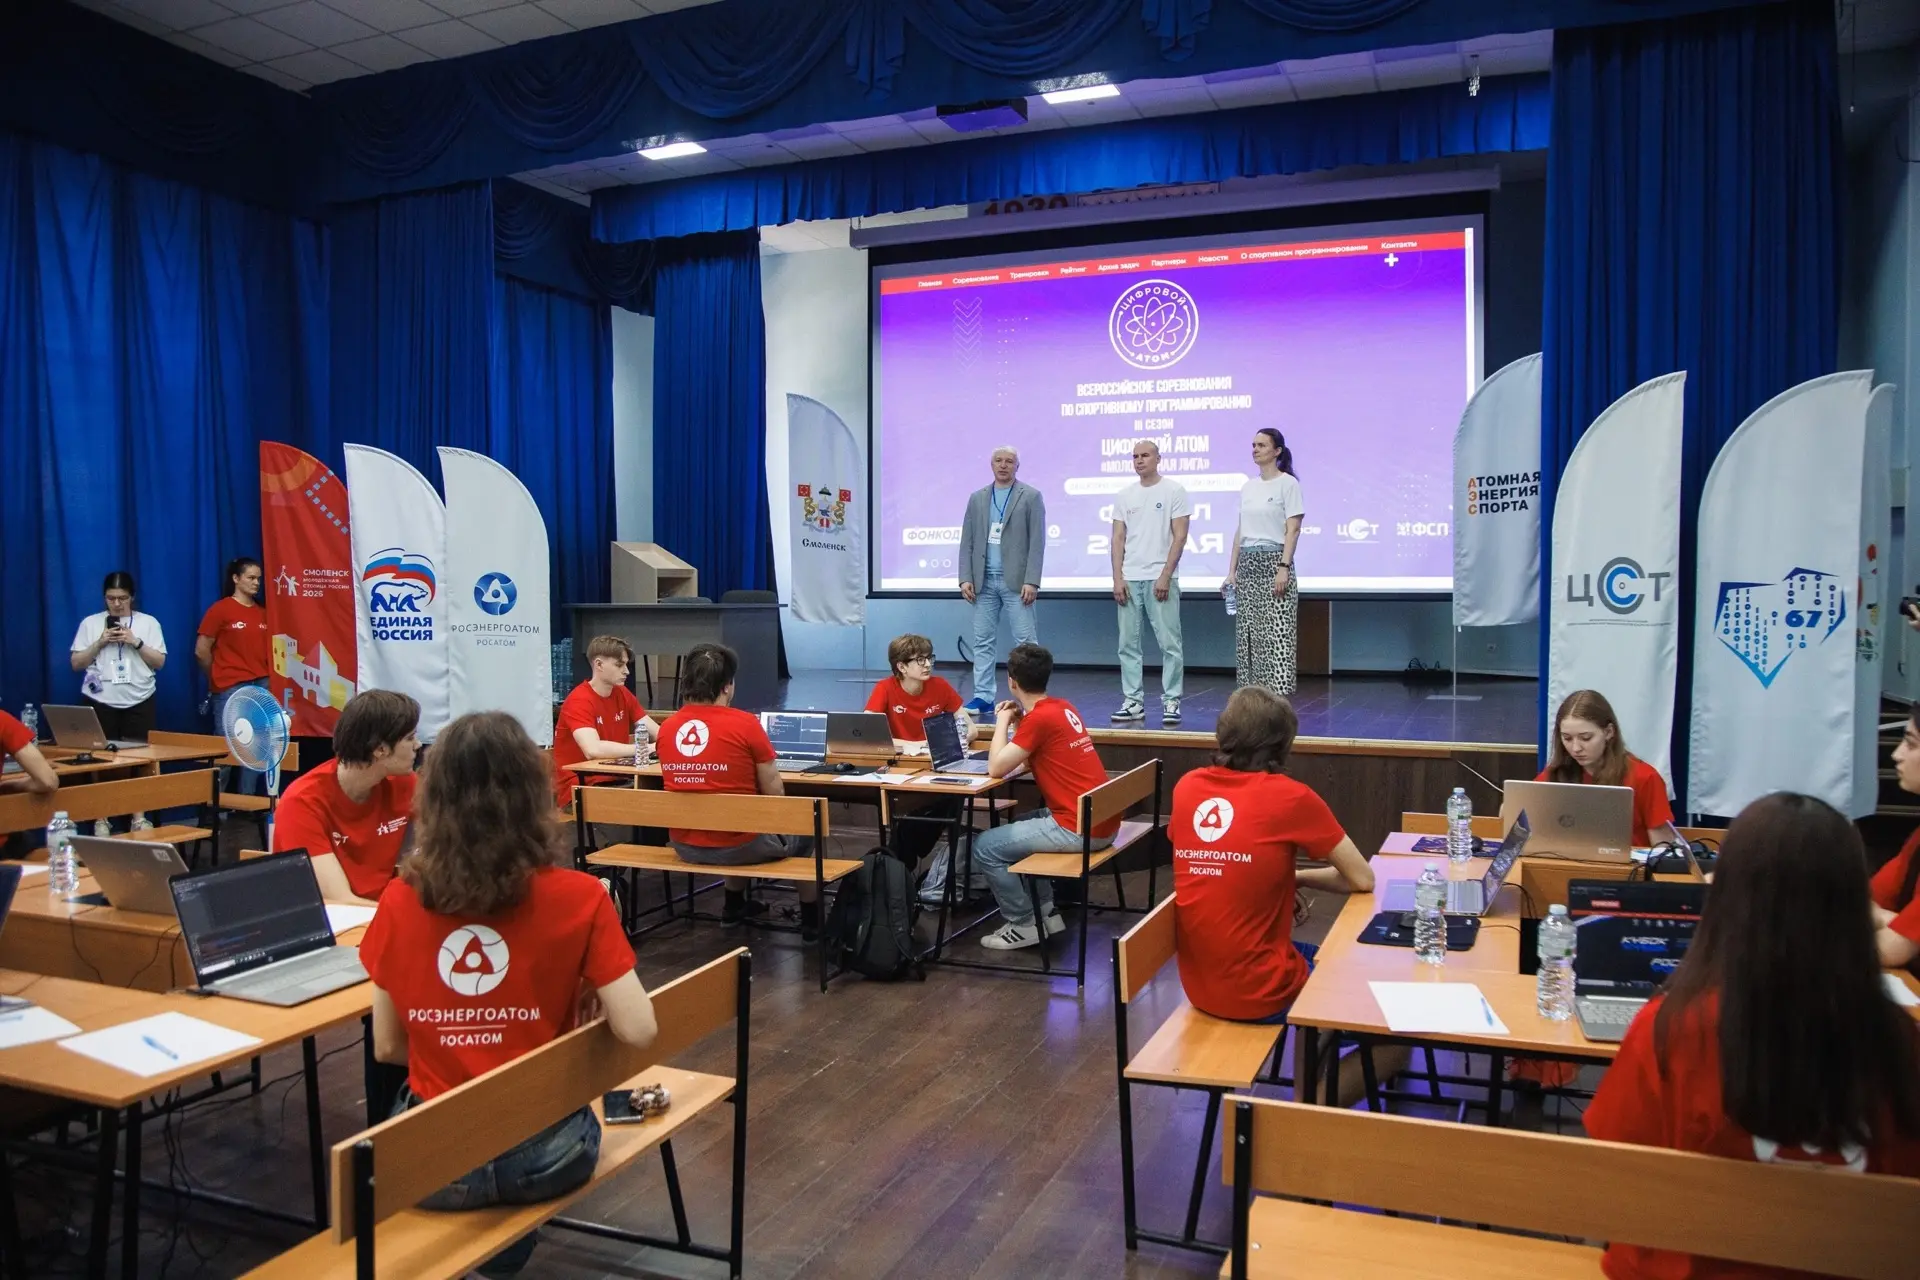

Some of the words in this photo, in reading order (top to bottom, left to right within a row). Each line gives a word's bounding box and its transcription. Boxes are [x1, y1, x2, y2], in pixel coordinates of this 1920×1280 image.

[1381, 240, 1418, 249] Контакты
[1198, 255, 1229, 263] Новости
[1240, 252, 1248, 260] О
[1248, 250, 1293, 260] спортивном
[1151, 257, 1187, 267] Партнеры
[1060, 266, 1087, 274] Рейтинг
[1120, 286, 1187, 311] ЦИФРОВОЙ
[1135, 351, 1170, 363] АТОМ
[1076, 379, 1155, 397] ВСЕРОССИЙСКИЕ
[1156, 376, 1232, 393] СОРЕВНОВАНИЯ
[1061, 403, 1075, 416] ПО
[1075, 399, 1144, 416] СПОРТИВНОМУ
[1145, 395, 1252, 413] ПРОГРАММИРОВАНИЮ
[1145, 418, 1174, 431] СЕЗОН
[1101, 433, 1172, 457] ЦИФОЙ
[1174, 435, 1210, 453] АТОМ
[1467, 471, 1541, 489] АТОМНАЯ
[1468, 485, 1539, 502] ЭНЕРГИЯ
[1468, 500, 1529, 515] СПОРТА
[908, 529, 960, 541] ФОНКОД
[1412, 521, 1449, 537] ФСП
[802, 538, 847, 551] Смоленск
[303, 568, 349, 577] СМОЛЕНСК
[370, 616, 433, 628] ЕДИНАЯ
[1785, 609, 1824, 628] 67
[451, 623, 540, 634] РОСЭНЕРГОАТОМ
[372, 629, 433, 641] РОССИЯ
[476, 639, 516, 647] РОСАТОМ
[674, 776, 706, 784] РОСАТОМ
[1175, 849, 1252, 863] РОСЭНЕРГОАТОМ
[1189, 866, 1223, 877] РОСАТОМ
[408, 1007, 541, 1023] РОСЭНЕРГОАТОМ
[440, 1032, 503, 1047] РОСАТОМ
